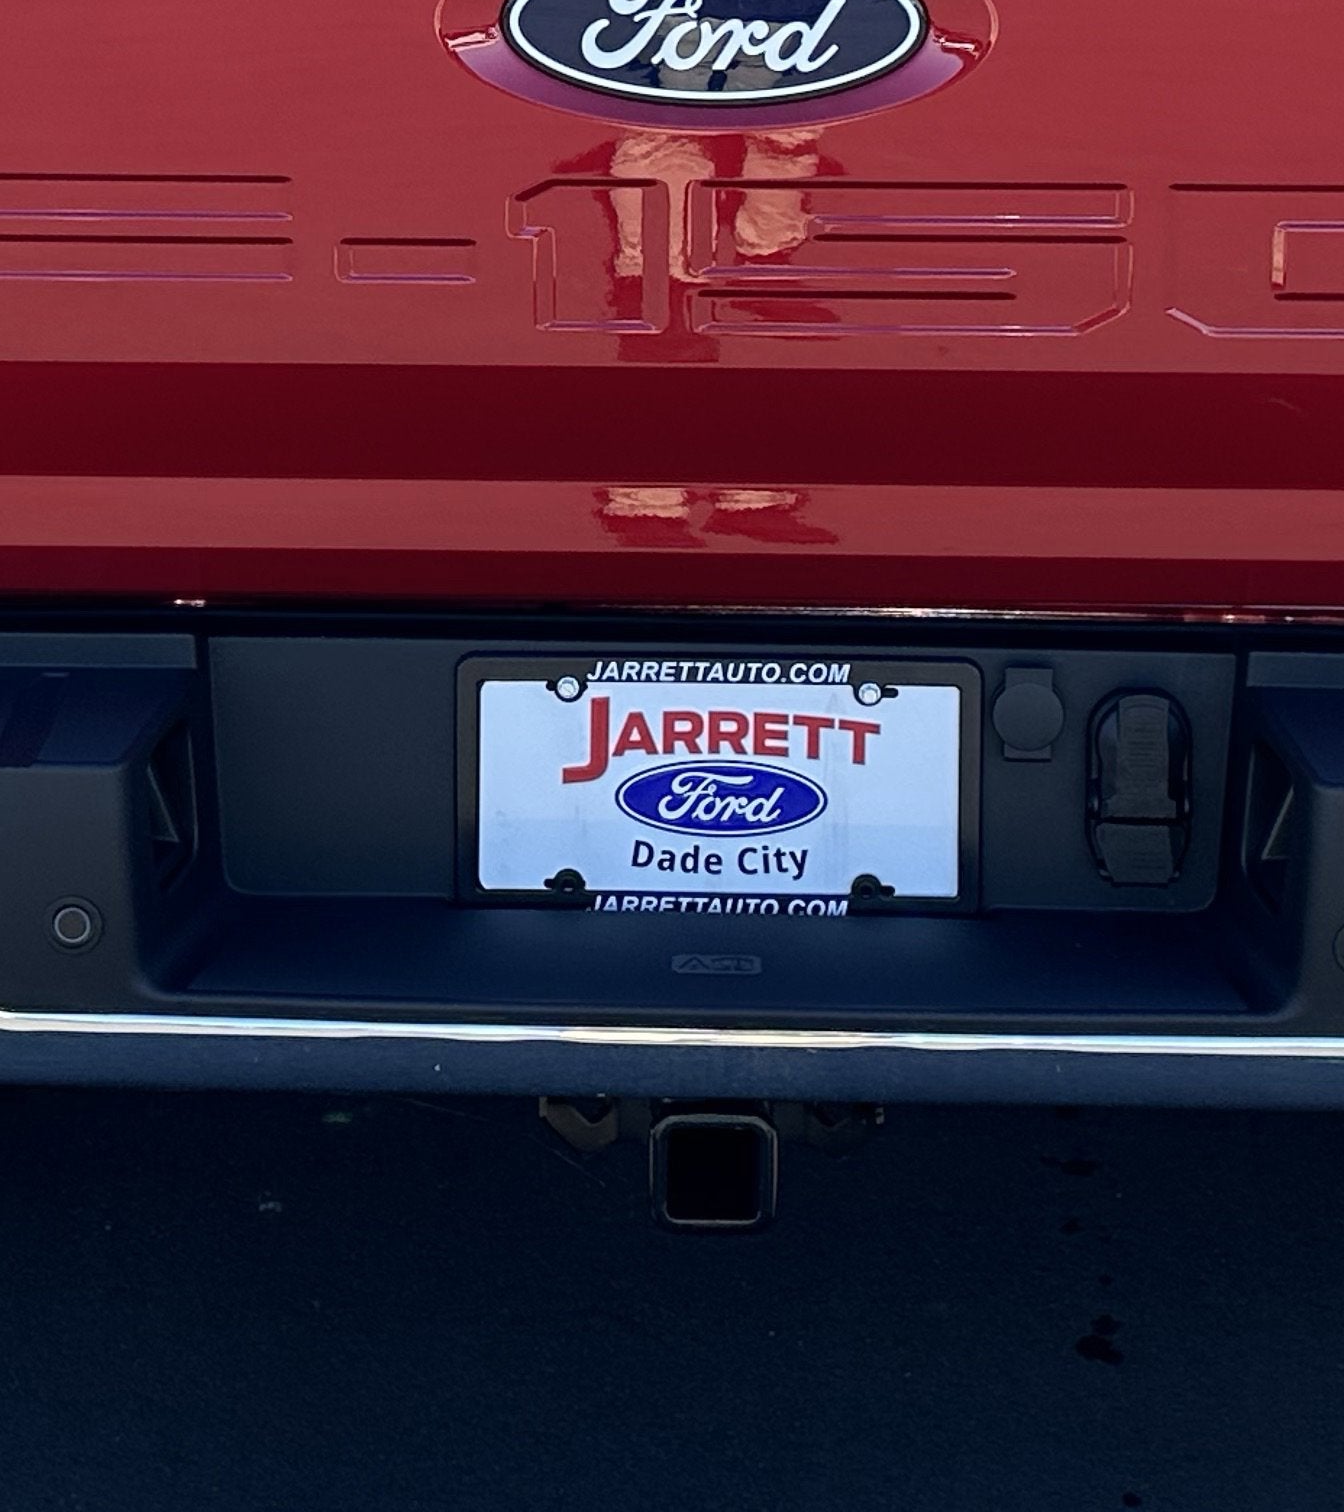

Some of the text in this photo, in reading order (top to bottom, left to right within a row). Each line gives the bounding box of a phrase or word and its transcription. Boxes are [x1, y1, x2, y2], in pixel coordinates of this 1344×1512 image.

[586, 661, 851, 684] JARRETTAUTO.COM
[561, 696, 882, 785] JARRETT
[657, 770, 786, 824] Ford
[630, 839, 809, 881] Dade City
[586, 894, 850, 917] JARRETTAUTOCOM
